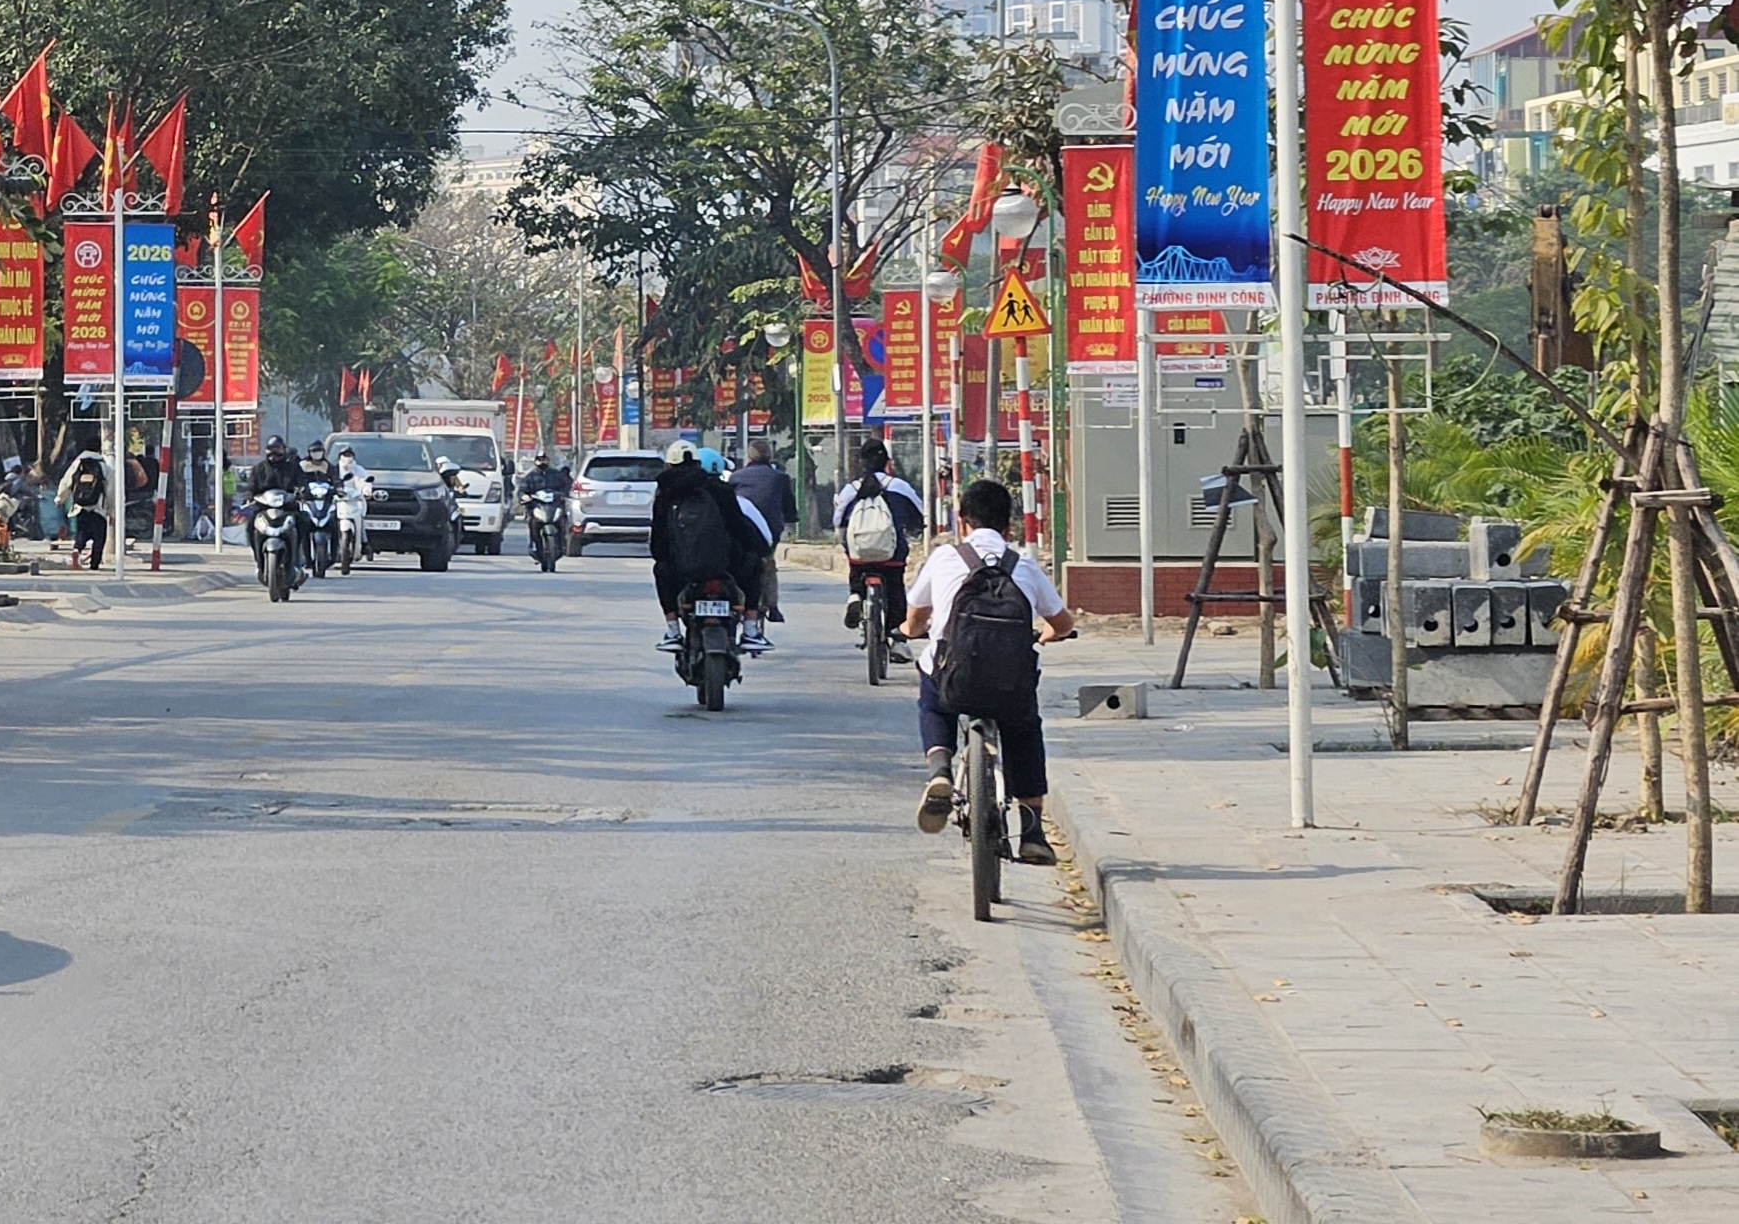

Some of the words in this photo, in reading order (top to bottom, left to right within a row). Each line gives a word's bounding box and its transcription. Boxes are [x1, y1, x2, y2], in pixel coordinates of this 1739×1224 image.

[1329, 1, 1417, 30] CHÚC
[1323, 38, 1422, 66] MỪNG
[1335, 73, 1410, 101] NĂM
[1164, 89, 1237, 124] NĂM
[1339, 109, 1409, 138] MỚI
[1168, 134, 1232, 171] MỚI
[1325, 147, 1424, 181] 2026
[1144, 184, 1188, 218] Happy
[1191, 184, 1222, 207] New
[1220, 184, 1261, 217] Year
[1316, 192, 1363, 216] Happy
[1365, 191, 1399, 210] New
[1402, 191, 1436, 211] Year
[12, 241, 38, 261] QUANG
[127, 244, 172, 262] 2026
[73, 274, 105, 285] CHÚC
[130, 272, 167, 286] CHÚC
[1141, 289, 1194, 306] PHƯỜNG
[1196, 290, 1228, 308] ĐỊNH
[1230, 288, 1266, 305] CÔNG
[134, 306, 162, 319] NĂM
[71, 326, 107, 339] 2026
[807, 393, 832, 403] 2026
[407, 416, 491, 429] CADI-SUN
